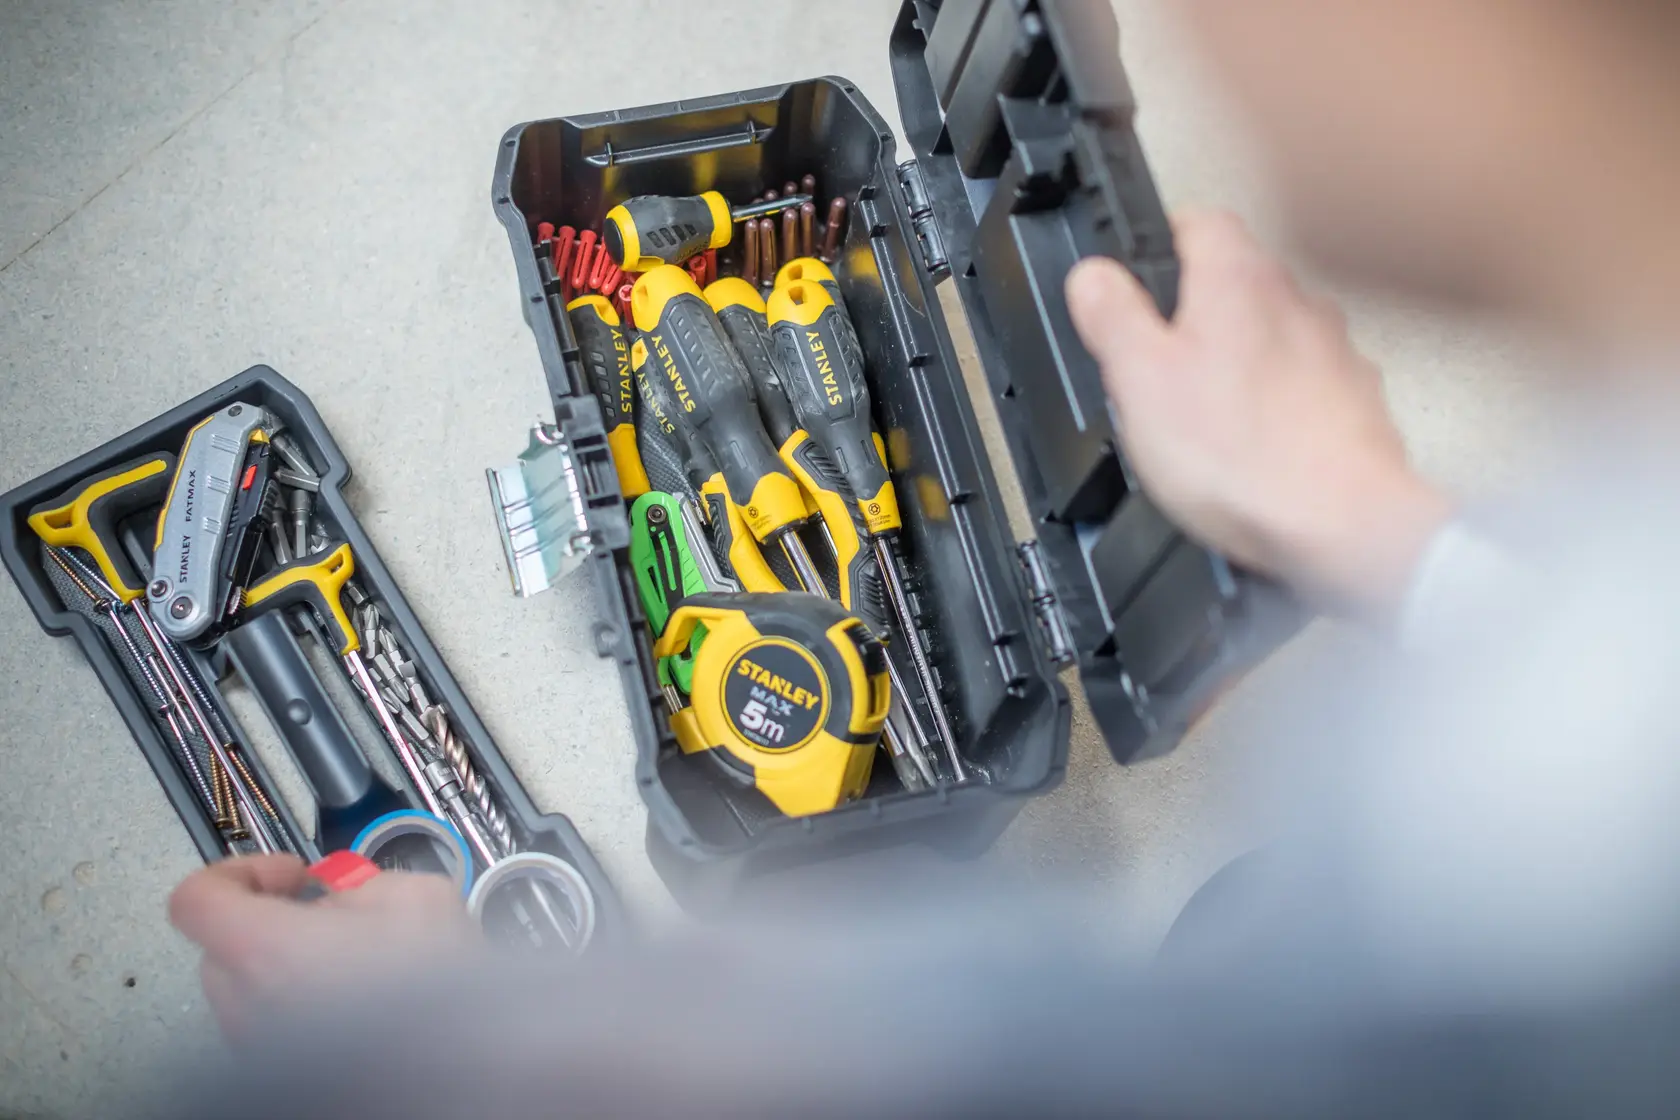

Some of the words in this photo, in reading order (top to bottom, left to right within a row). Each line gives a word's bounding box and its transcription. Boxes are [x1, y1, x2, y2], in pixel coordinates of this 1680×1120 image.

[610, 329, 632, 413] STANLEY
[652, 335, 696, 413] STANLEY
[806, 331, 843, 406] STANLEY
[638, 373, 676, 434] STANLEY
[179, 535, 191, 583] STANLEY
[185, 469, 196, 522] FATMAX
[737, 659, 820, 711] STANLEY
[749, 686, 795, 716] MAX
[740, 699, 784, 743] 5m
